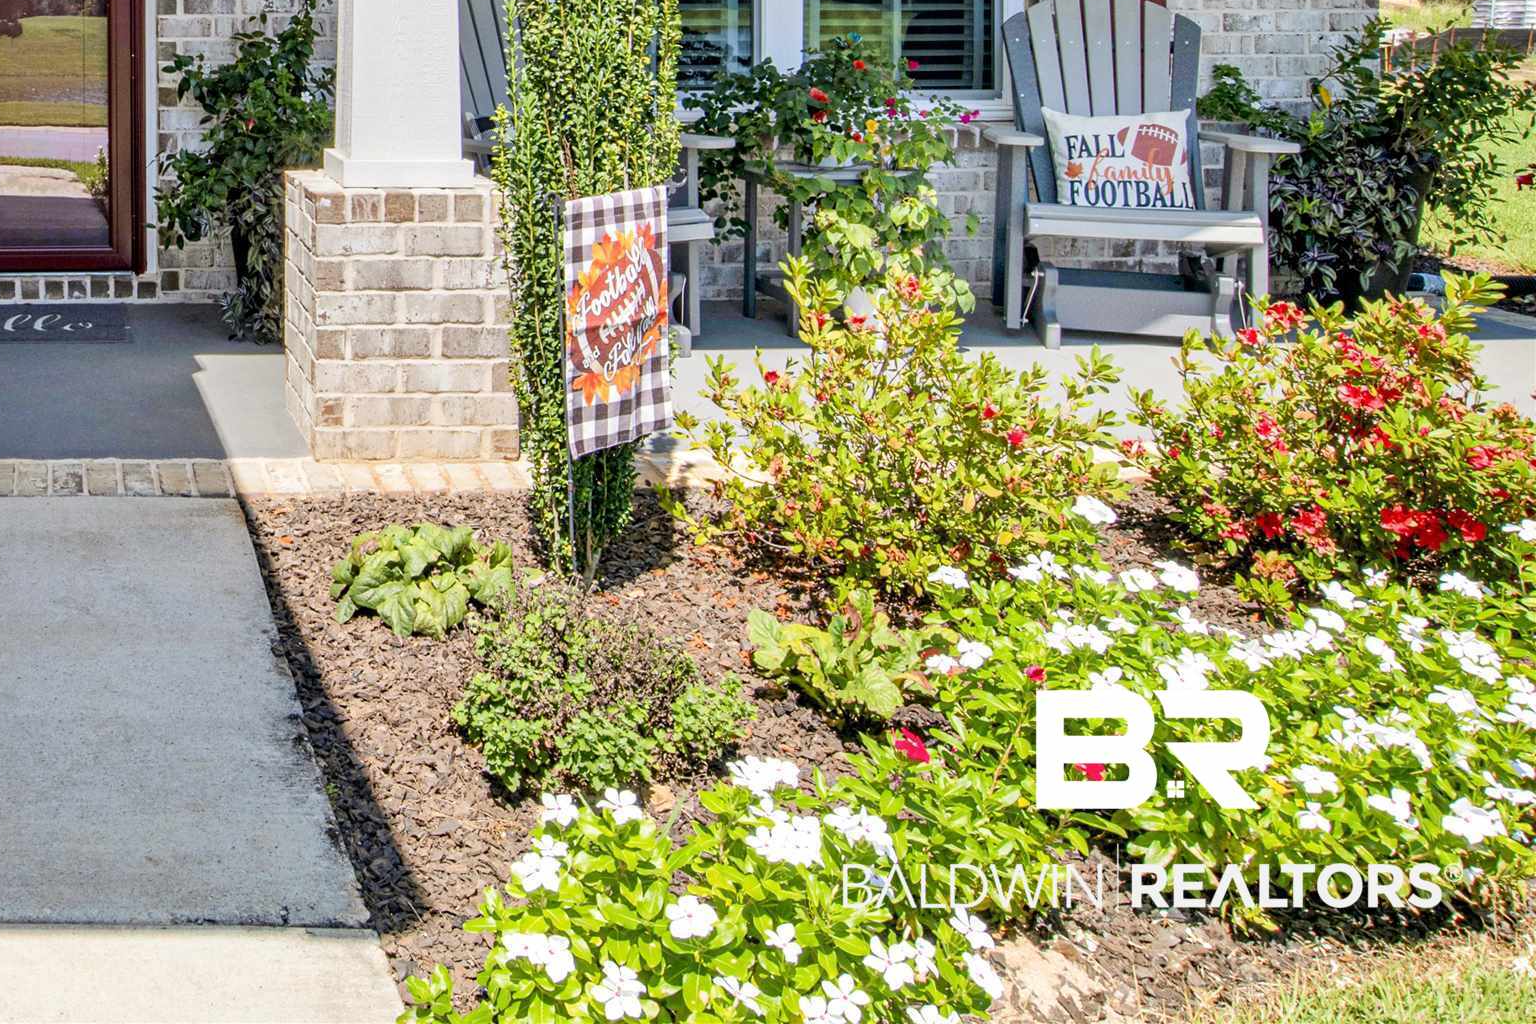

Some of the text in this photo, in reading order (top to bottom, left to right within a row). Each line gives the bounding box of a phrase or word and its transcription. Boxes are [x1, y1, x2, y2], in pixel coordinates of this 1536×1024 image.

[1064, 134, 1125, 160] FALL
[1088, 147, 1174, 196] family
[1069, 180, 1194, 210] FOOTBALL
[572, 236, 648, 336] Football
[582, 345, 600, 369] and
